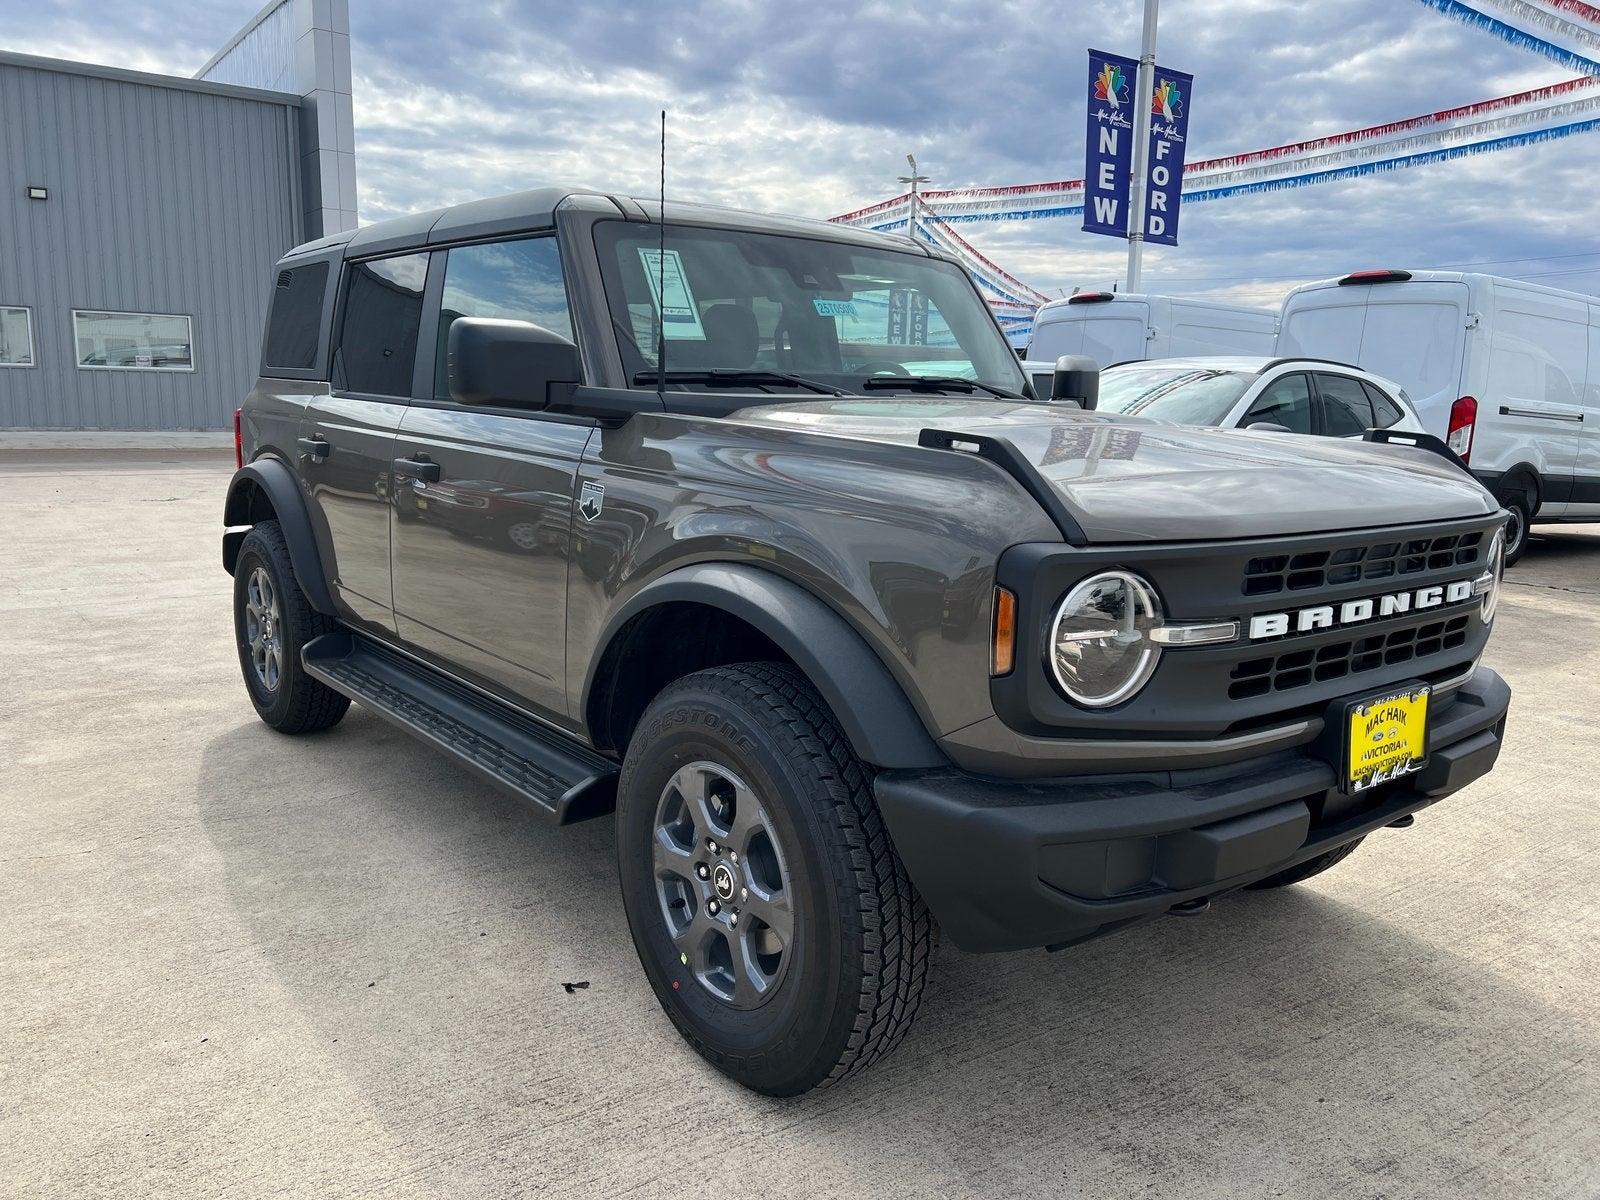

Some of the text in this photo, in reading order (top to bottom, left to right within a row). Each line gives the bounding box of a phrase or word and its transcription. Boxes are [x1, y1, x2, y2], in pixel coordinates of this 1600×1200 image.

[1112, 121, 1131, 129] VICTORIA
[1093, 126, 1118, 225] NEW
[1149, 140, 1171, 236] FORD
[1250, 580, 1471, 639] BRONCO
[1365, 709, 1386, 738] MAC
[1386, 707, 1407, 726] HAIK
[1367, 741, 1401, 760] VICTORIA
[1362, 768, 1390, 790] Mac
